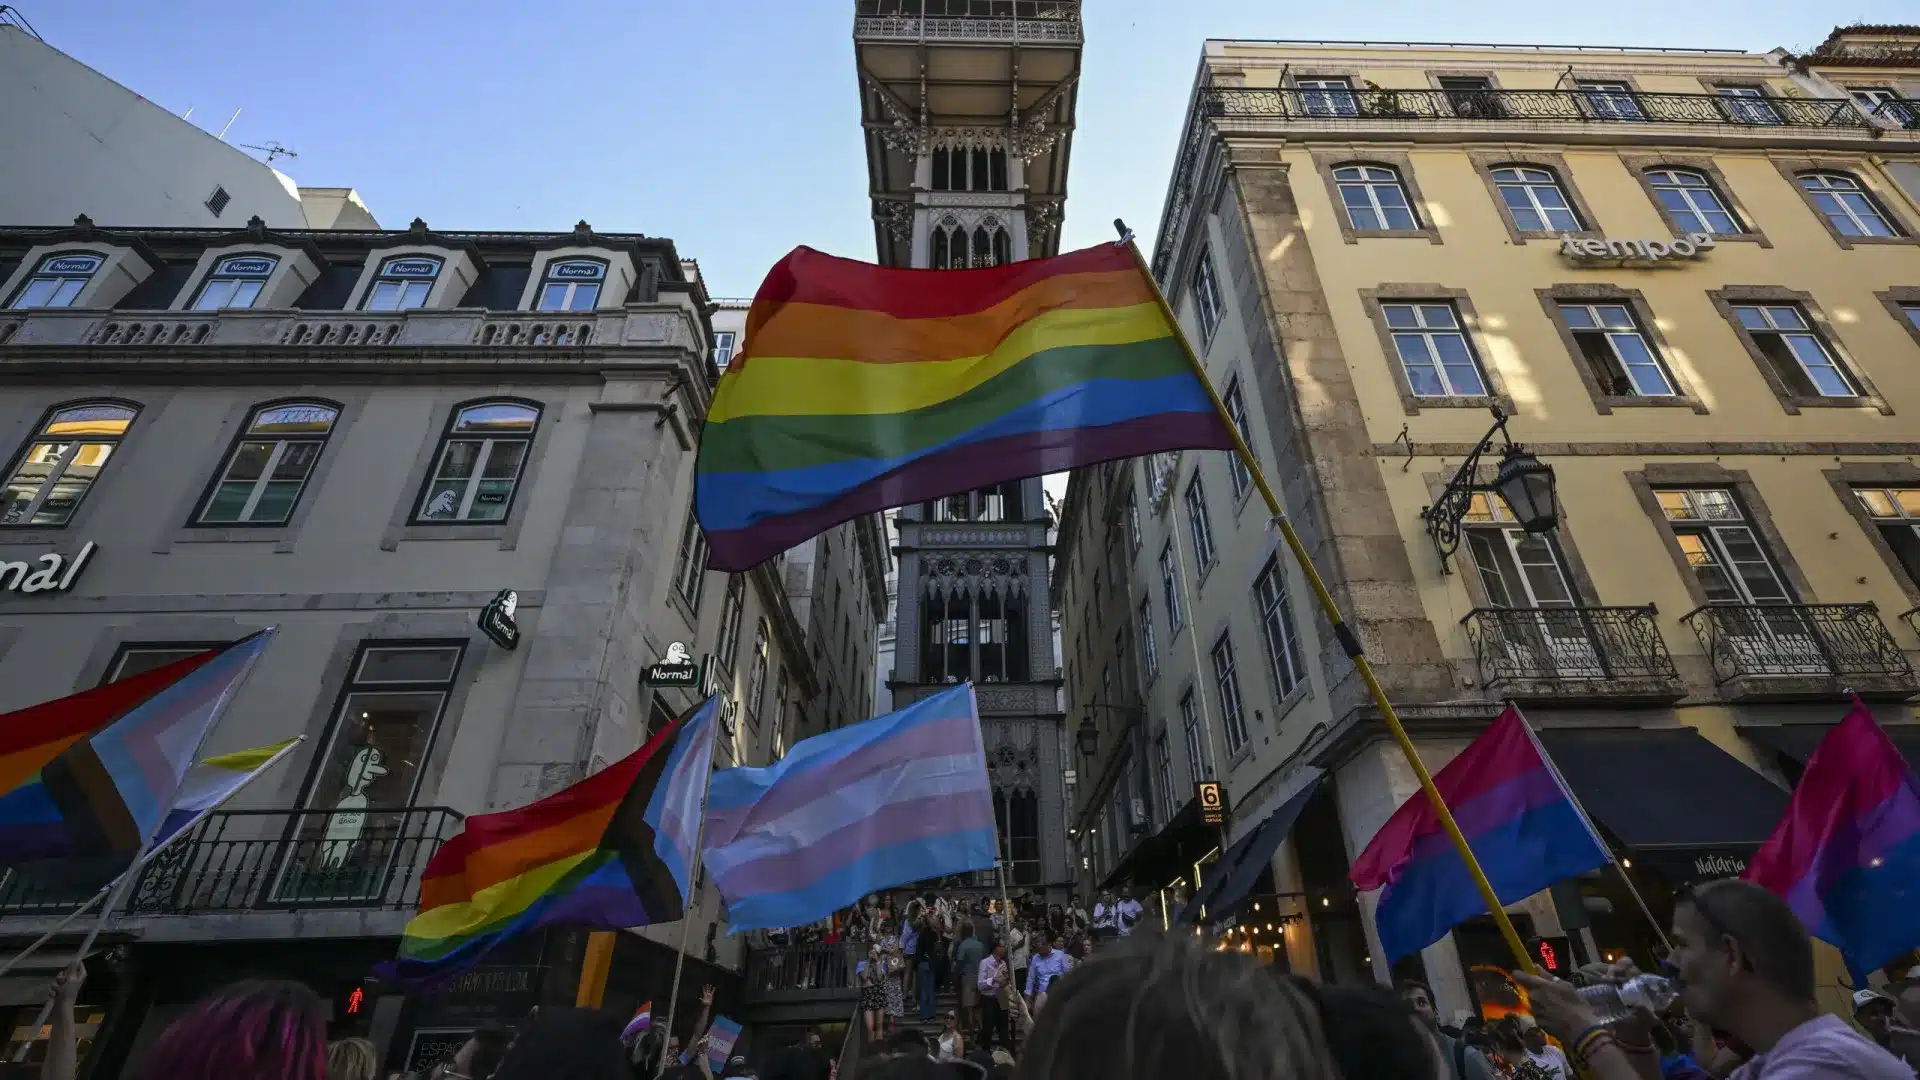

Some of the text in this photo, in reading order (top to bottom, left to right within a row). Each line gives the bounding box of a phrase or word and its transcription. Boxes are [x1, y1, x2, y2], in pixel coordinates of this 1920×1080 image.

[1561, 231, 1694, 262] tempo
[54, 261, 90, 271] Normal
[230, 262, 265, 272] Normal
[395, 264, 429, 273] Normal
[561, 265, 595, 275] Normal
[492, 612, 515, 640] Normal
[652, 668, 694, 680] Normal
[1203, 786, 1217, 805] 6
[1694, 854, 1747, 875] Nataria
